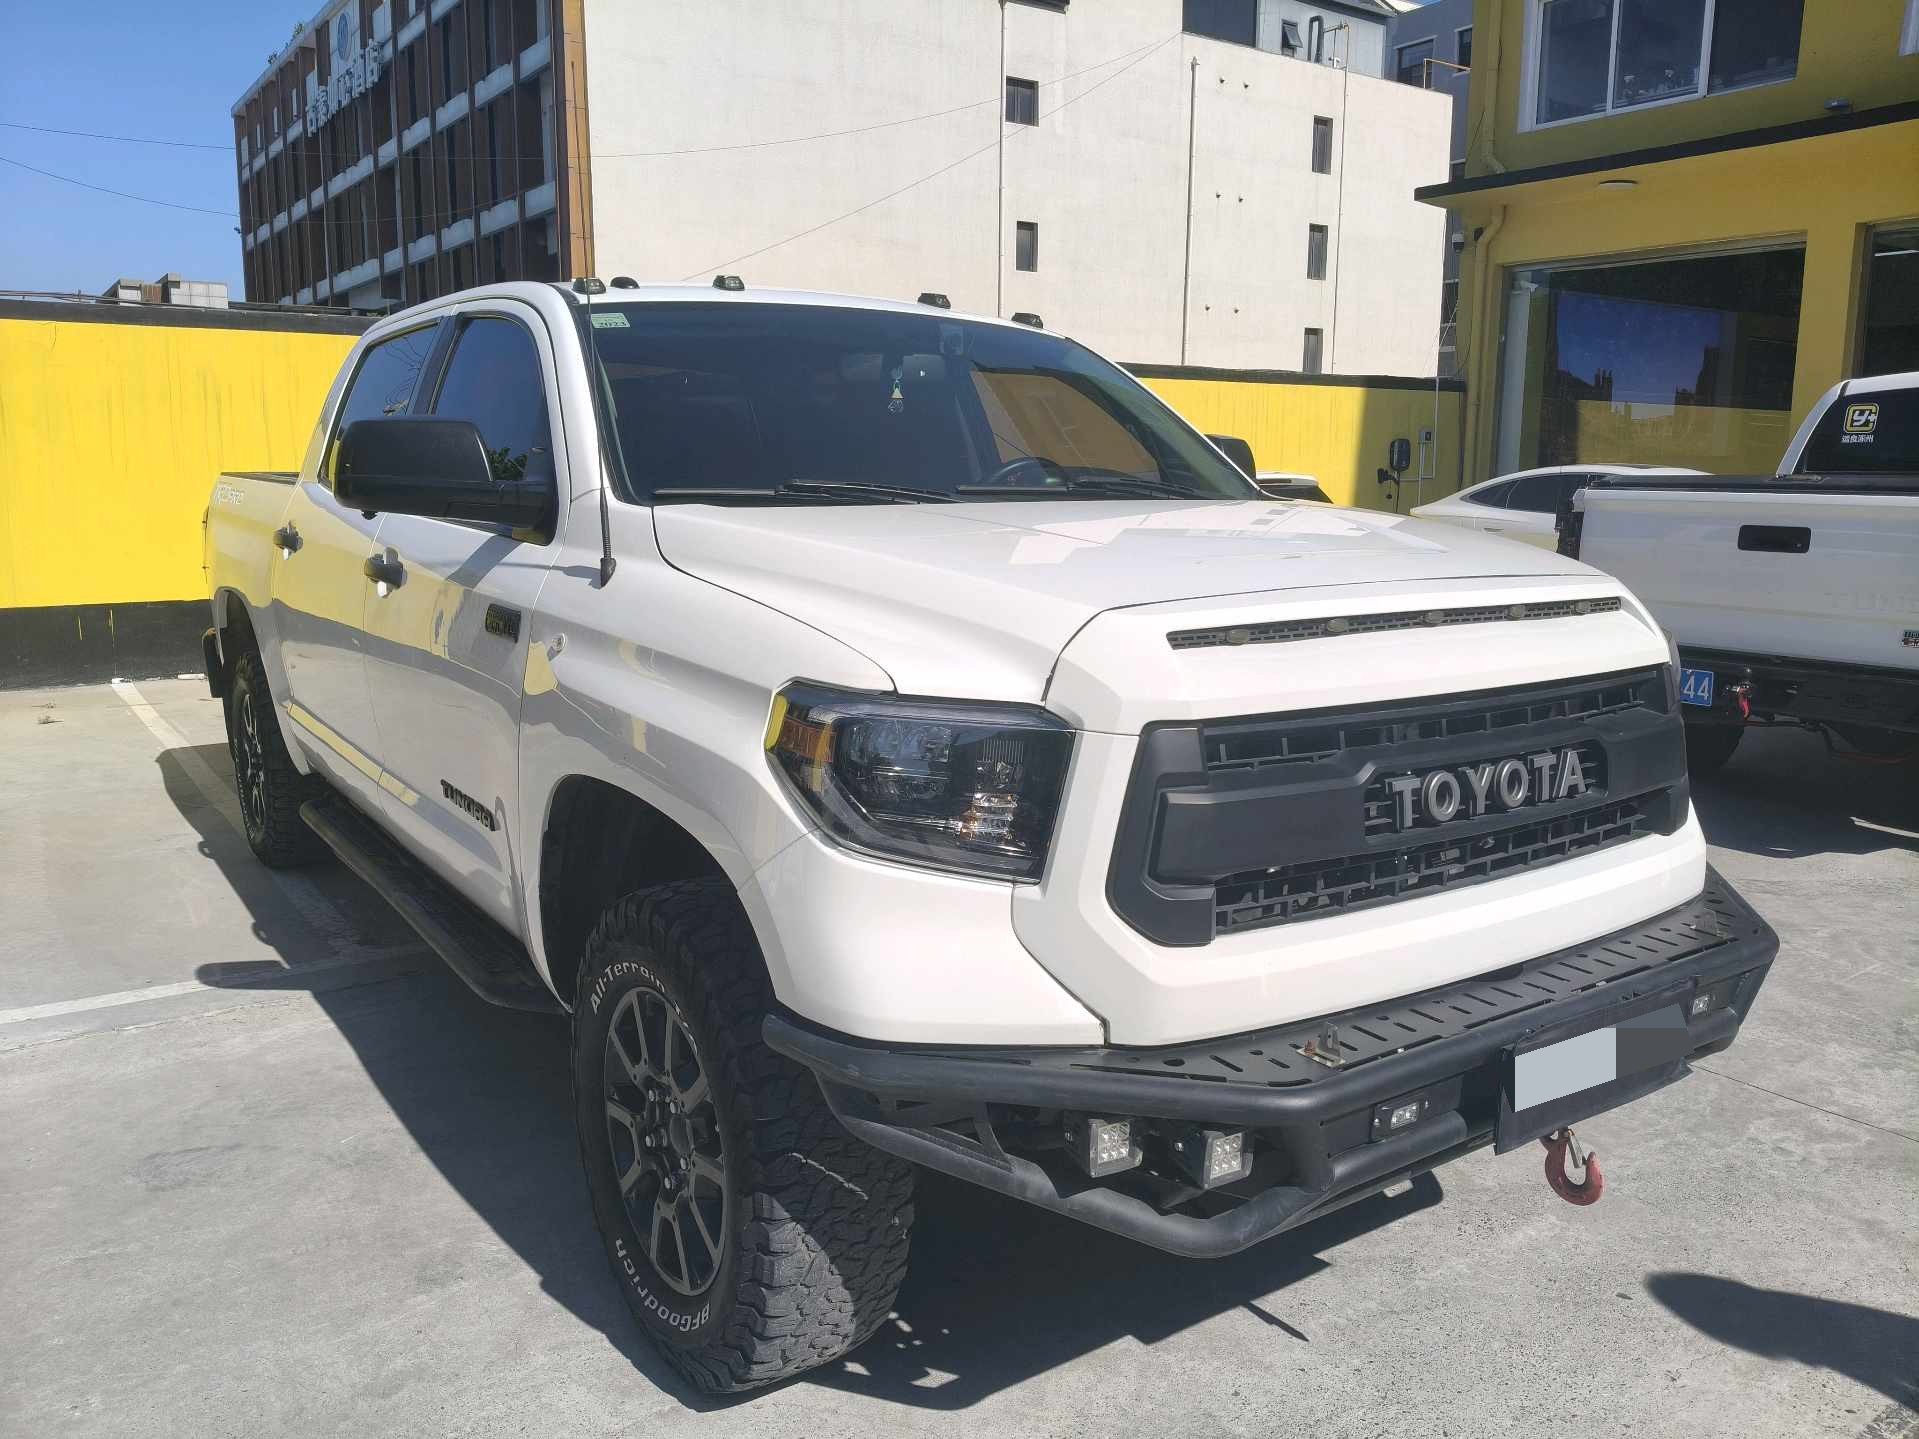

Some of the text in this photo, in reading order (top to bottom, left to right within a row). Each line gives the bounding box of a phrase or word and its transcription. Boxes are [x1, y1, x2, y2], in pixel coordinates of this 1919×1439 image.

[1683, 675, 1709, 701] 44
[1388, 750, 1587, 828] TOYOTA
[616, 1238, 710, 1332] BFGoodrich
